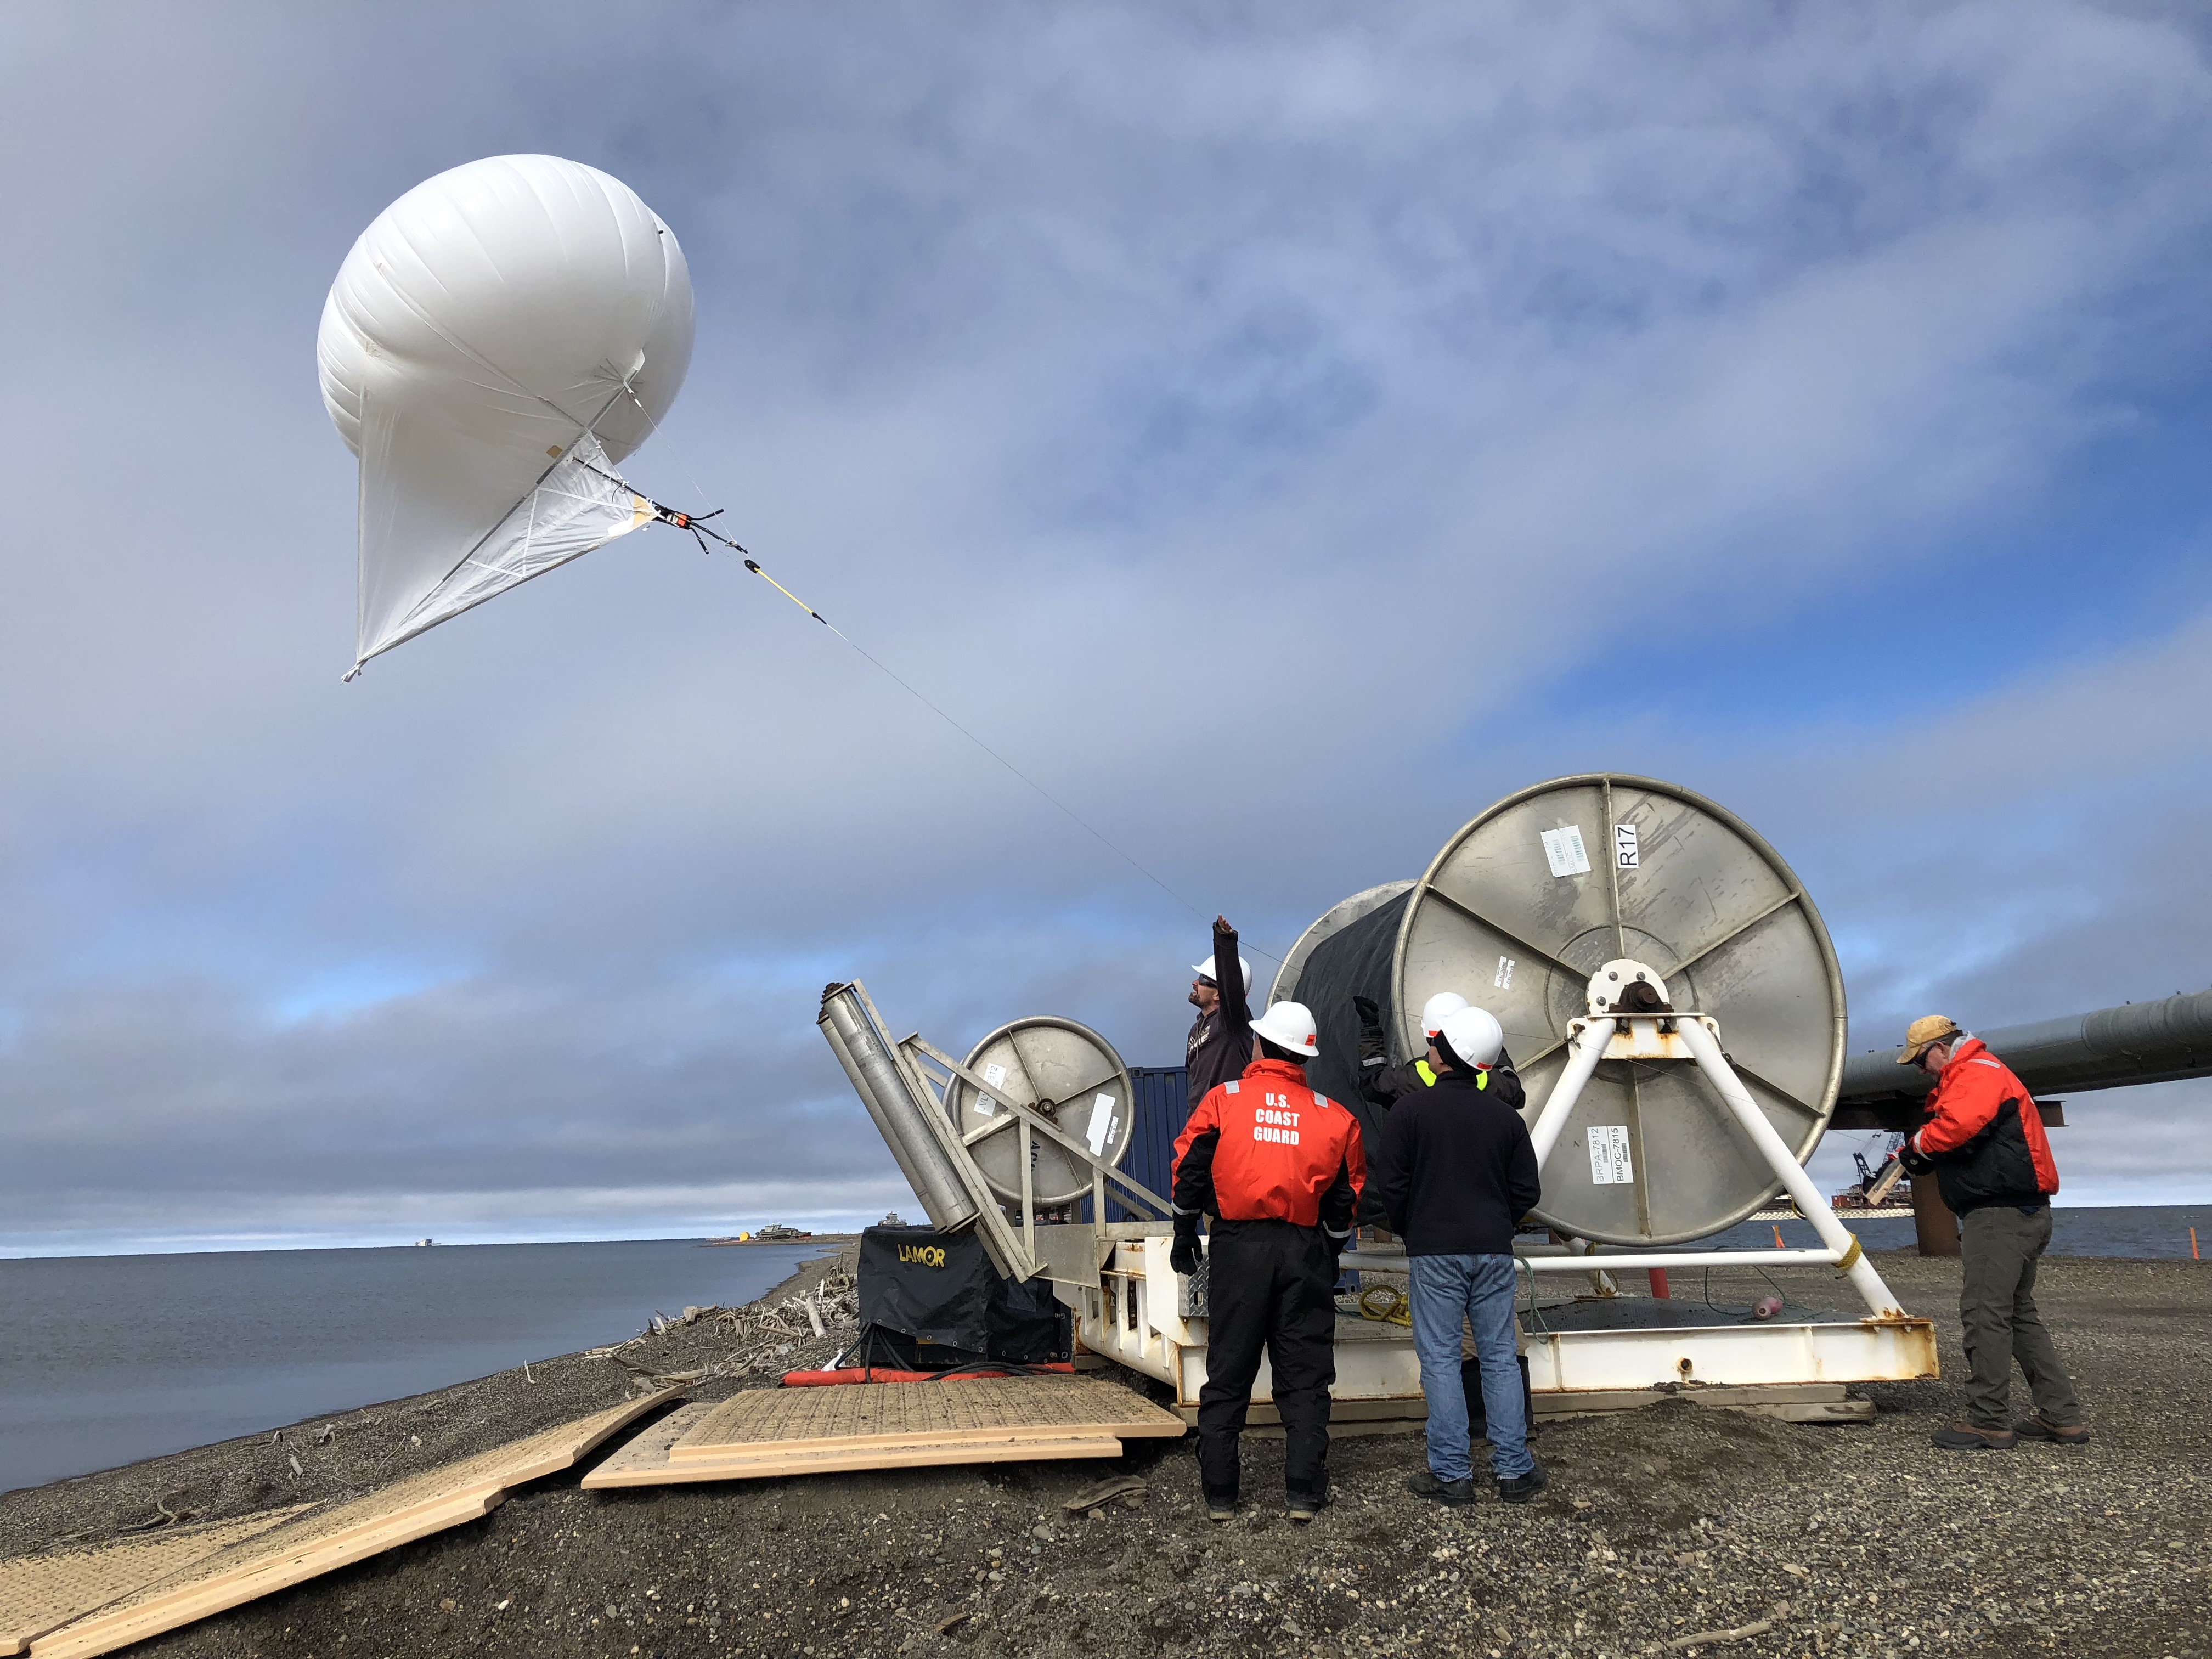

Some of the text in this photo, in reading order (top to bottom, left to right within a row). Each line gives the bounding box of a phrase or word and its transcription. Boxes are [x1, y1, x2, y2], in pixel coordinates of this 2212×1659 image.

[1617, 826, 1637, 865] R17
[1265, 1092, 1290, 1108] U.S.
[1255, 1108, 1300, 1127] COAST
[1254, 1126, 1299, 1146] GUARD
[1590, 1128, 1604, 1182] BRPA-7812
[1611, 1127, 1624, 1182] BMOC-7815
[897, 1244, 945, 1267] LAMOR
